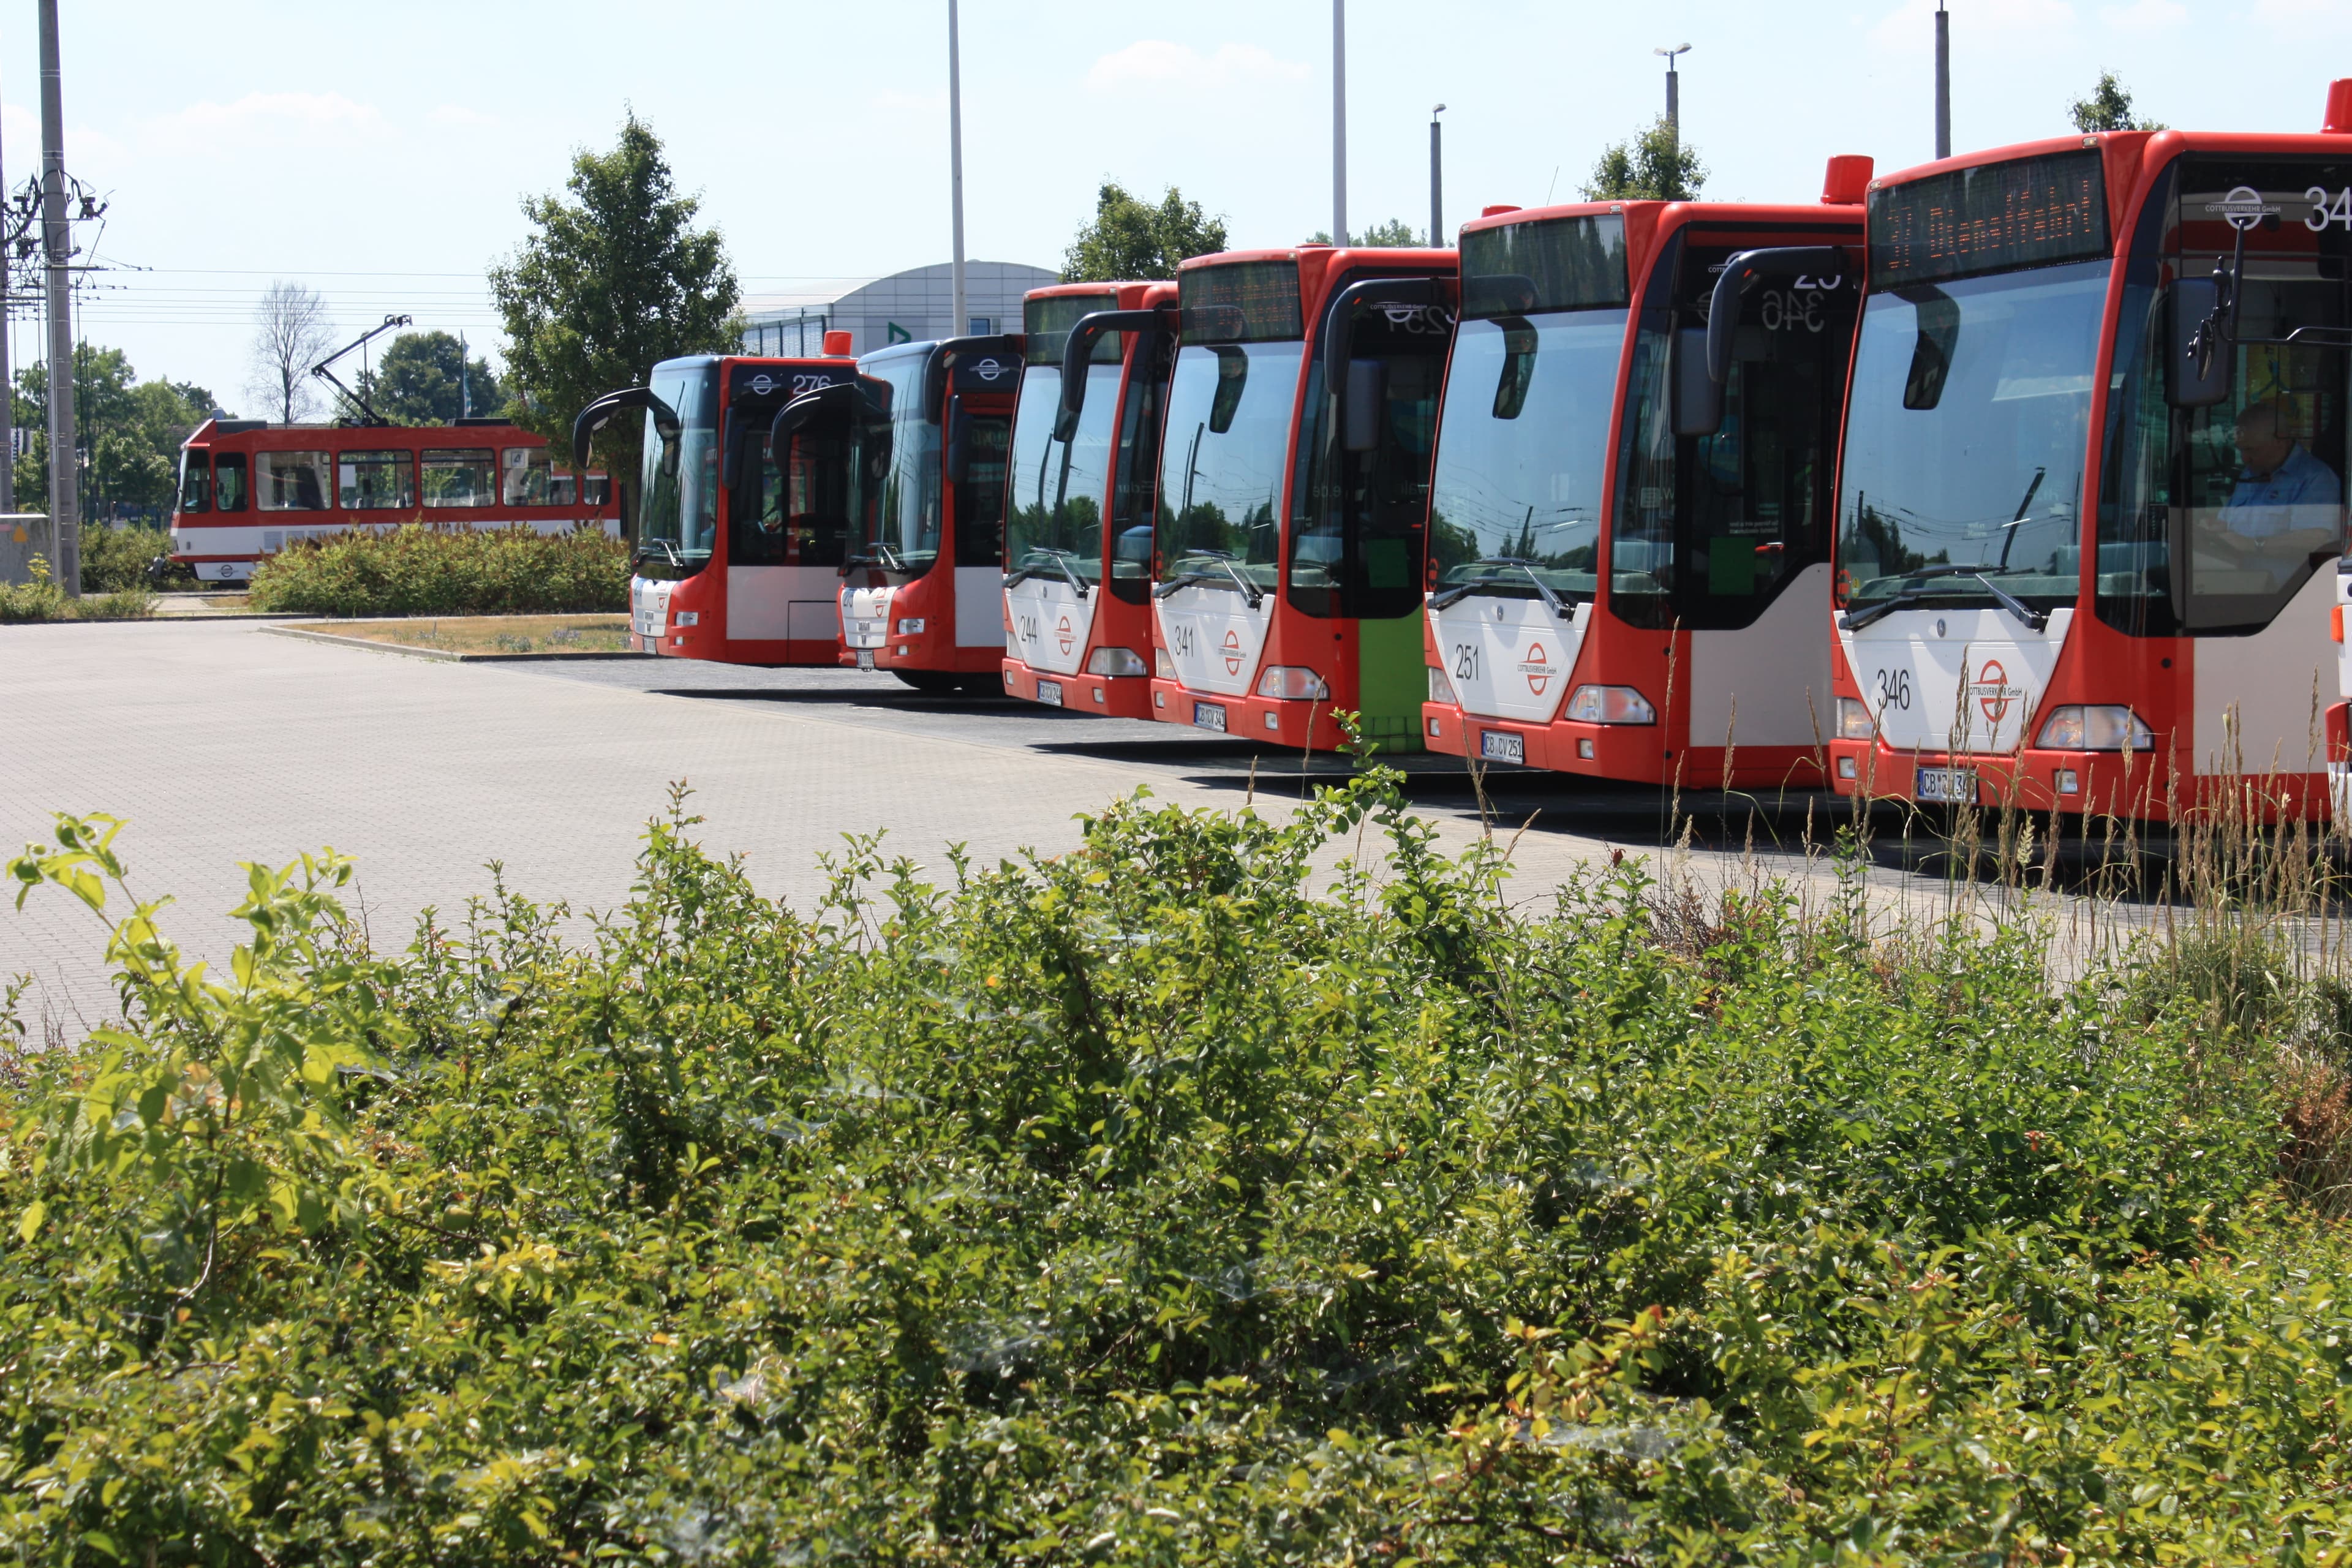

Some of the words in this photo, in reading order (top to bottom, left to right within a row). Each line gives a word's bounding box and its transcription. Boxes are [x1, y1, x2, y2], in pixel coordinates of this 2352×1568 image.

[1929, 180, 2092, 258] Dienstfahrt
[1021, 616, 1037, 644] 244
[1175, 625, 1194, 657] 341
[1456, 644, 1479, 681] 251
[1877, 669, 1910, 711] 346
[2007, 687, 2022, 696] GmbH
[1486, 736, 1494, 753] CB
[1499, 737, 1507, 755] CV
[1509, 739, 1522, 757] 251
[1924, 773, 1936, 794] CB
